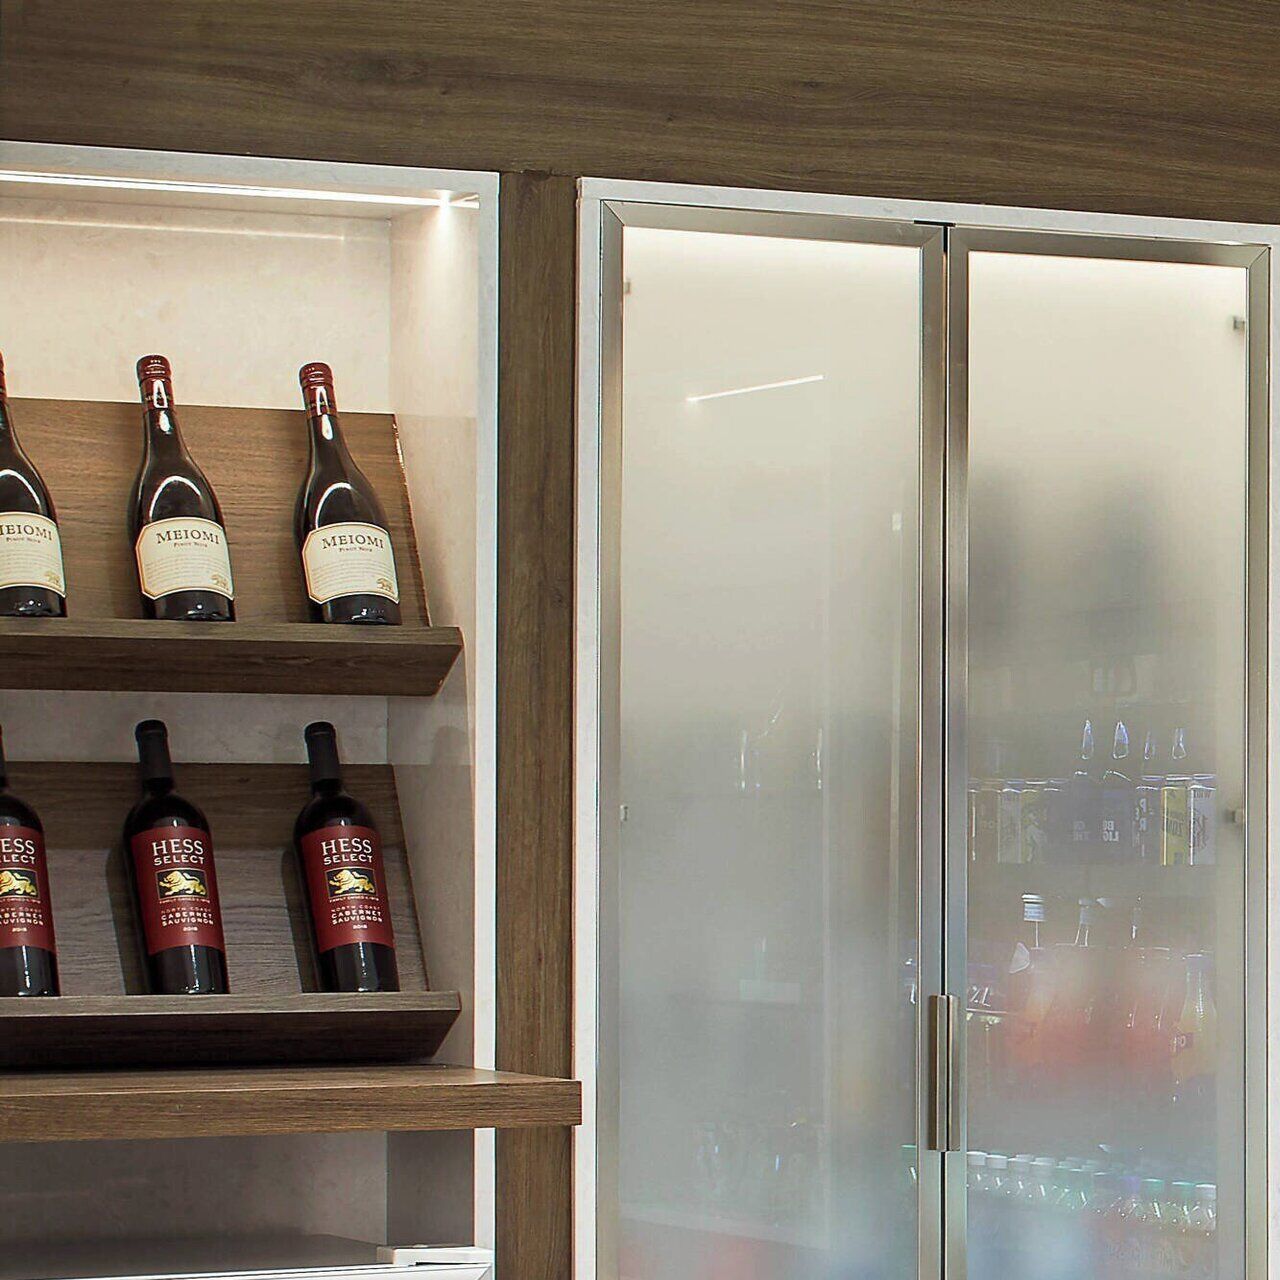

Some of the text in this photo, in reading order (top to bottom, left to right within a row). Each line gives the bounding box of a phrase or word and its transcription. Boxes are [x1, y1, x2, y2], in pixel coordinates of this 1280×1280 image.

[156, 529, 220, 545] MEIOMI
[321, 534, 385, 550] MEIOMI
[0, 838, 35, 855] ESS
[152, 838, 204, 857] HESS
[321, 838, 373, 856] HESS
[154, 854, 205, 866] SELECT
[324, 854, 373, 865] SELECT
[161, 911, 213, 921] CABERNET
[331, 910, 382, 919] CABERNET
[332, 915, 383, 925] SAUVIGNON
[162, 917, 214, 926] SAUVIGNON
